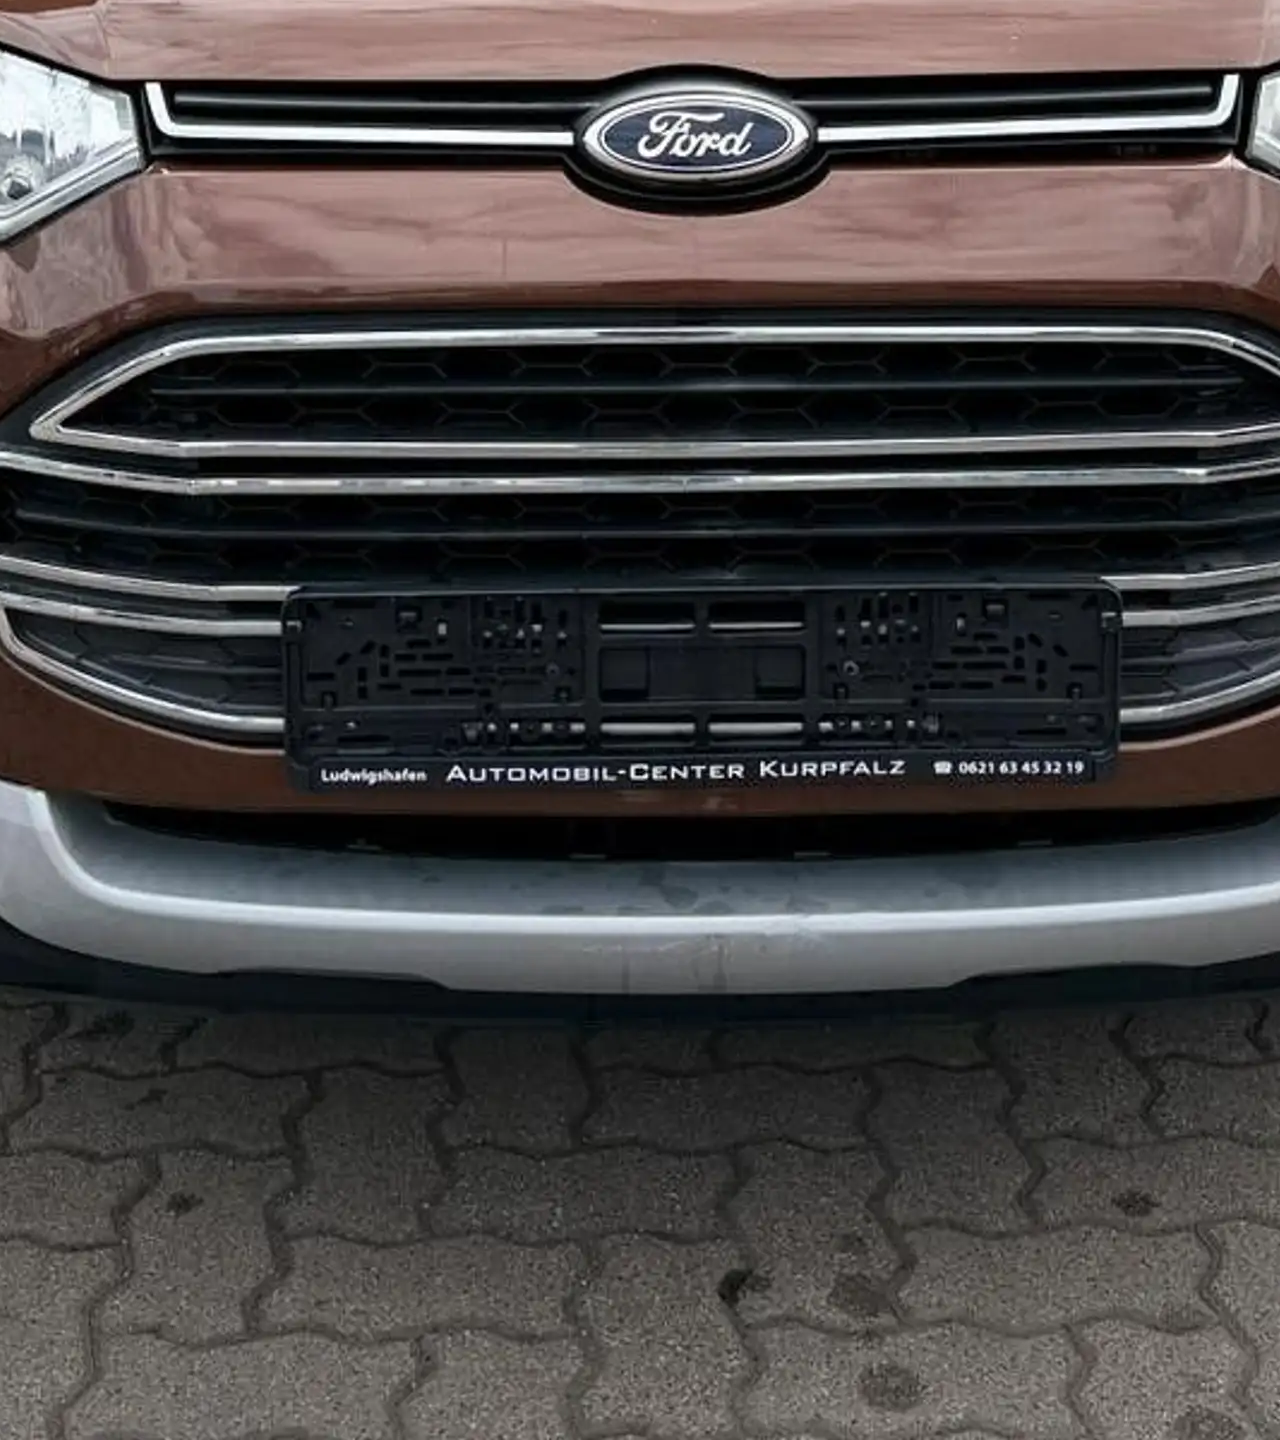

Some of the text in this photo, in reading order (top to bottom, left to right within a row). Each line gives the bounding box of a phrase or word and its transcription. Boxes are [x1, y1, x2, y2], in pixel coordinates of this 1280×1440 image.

[637, 110, 754, 159] Ford
[320, 759, 1085, 785] Ludwigshafen AUTOMOBIL-CENTER KURPFALZ 0621 63 45 32 19
